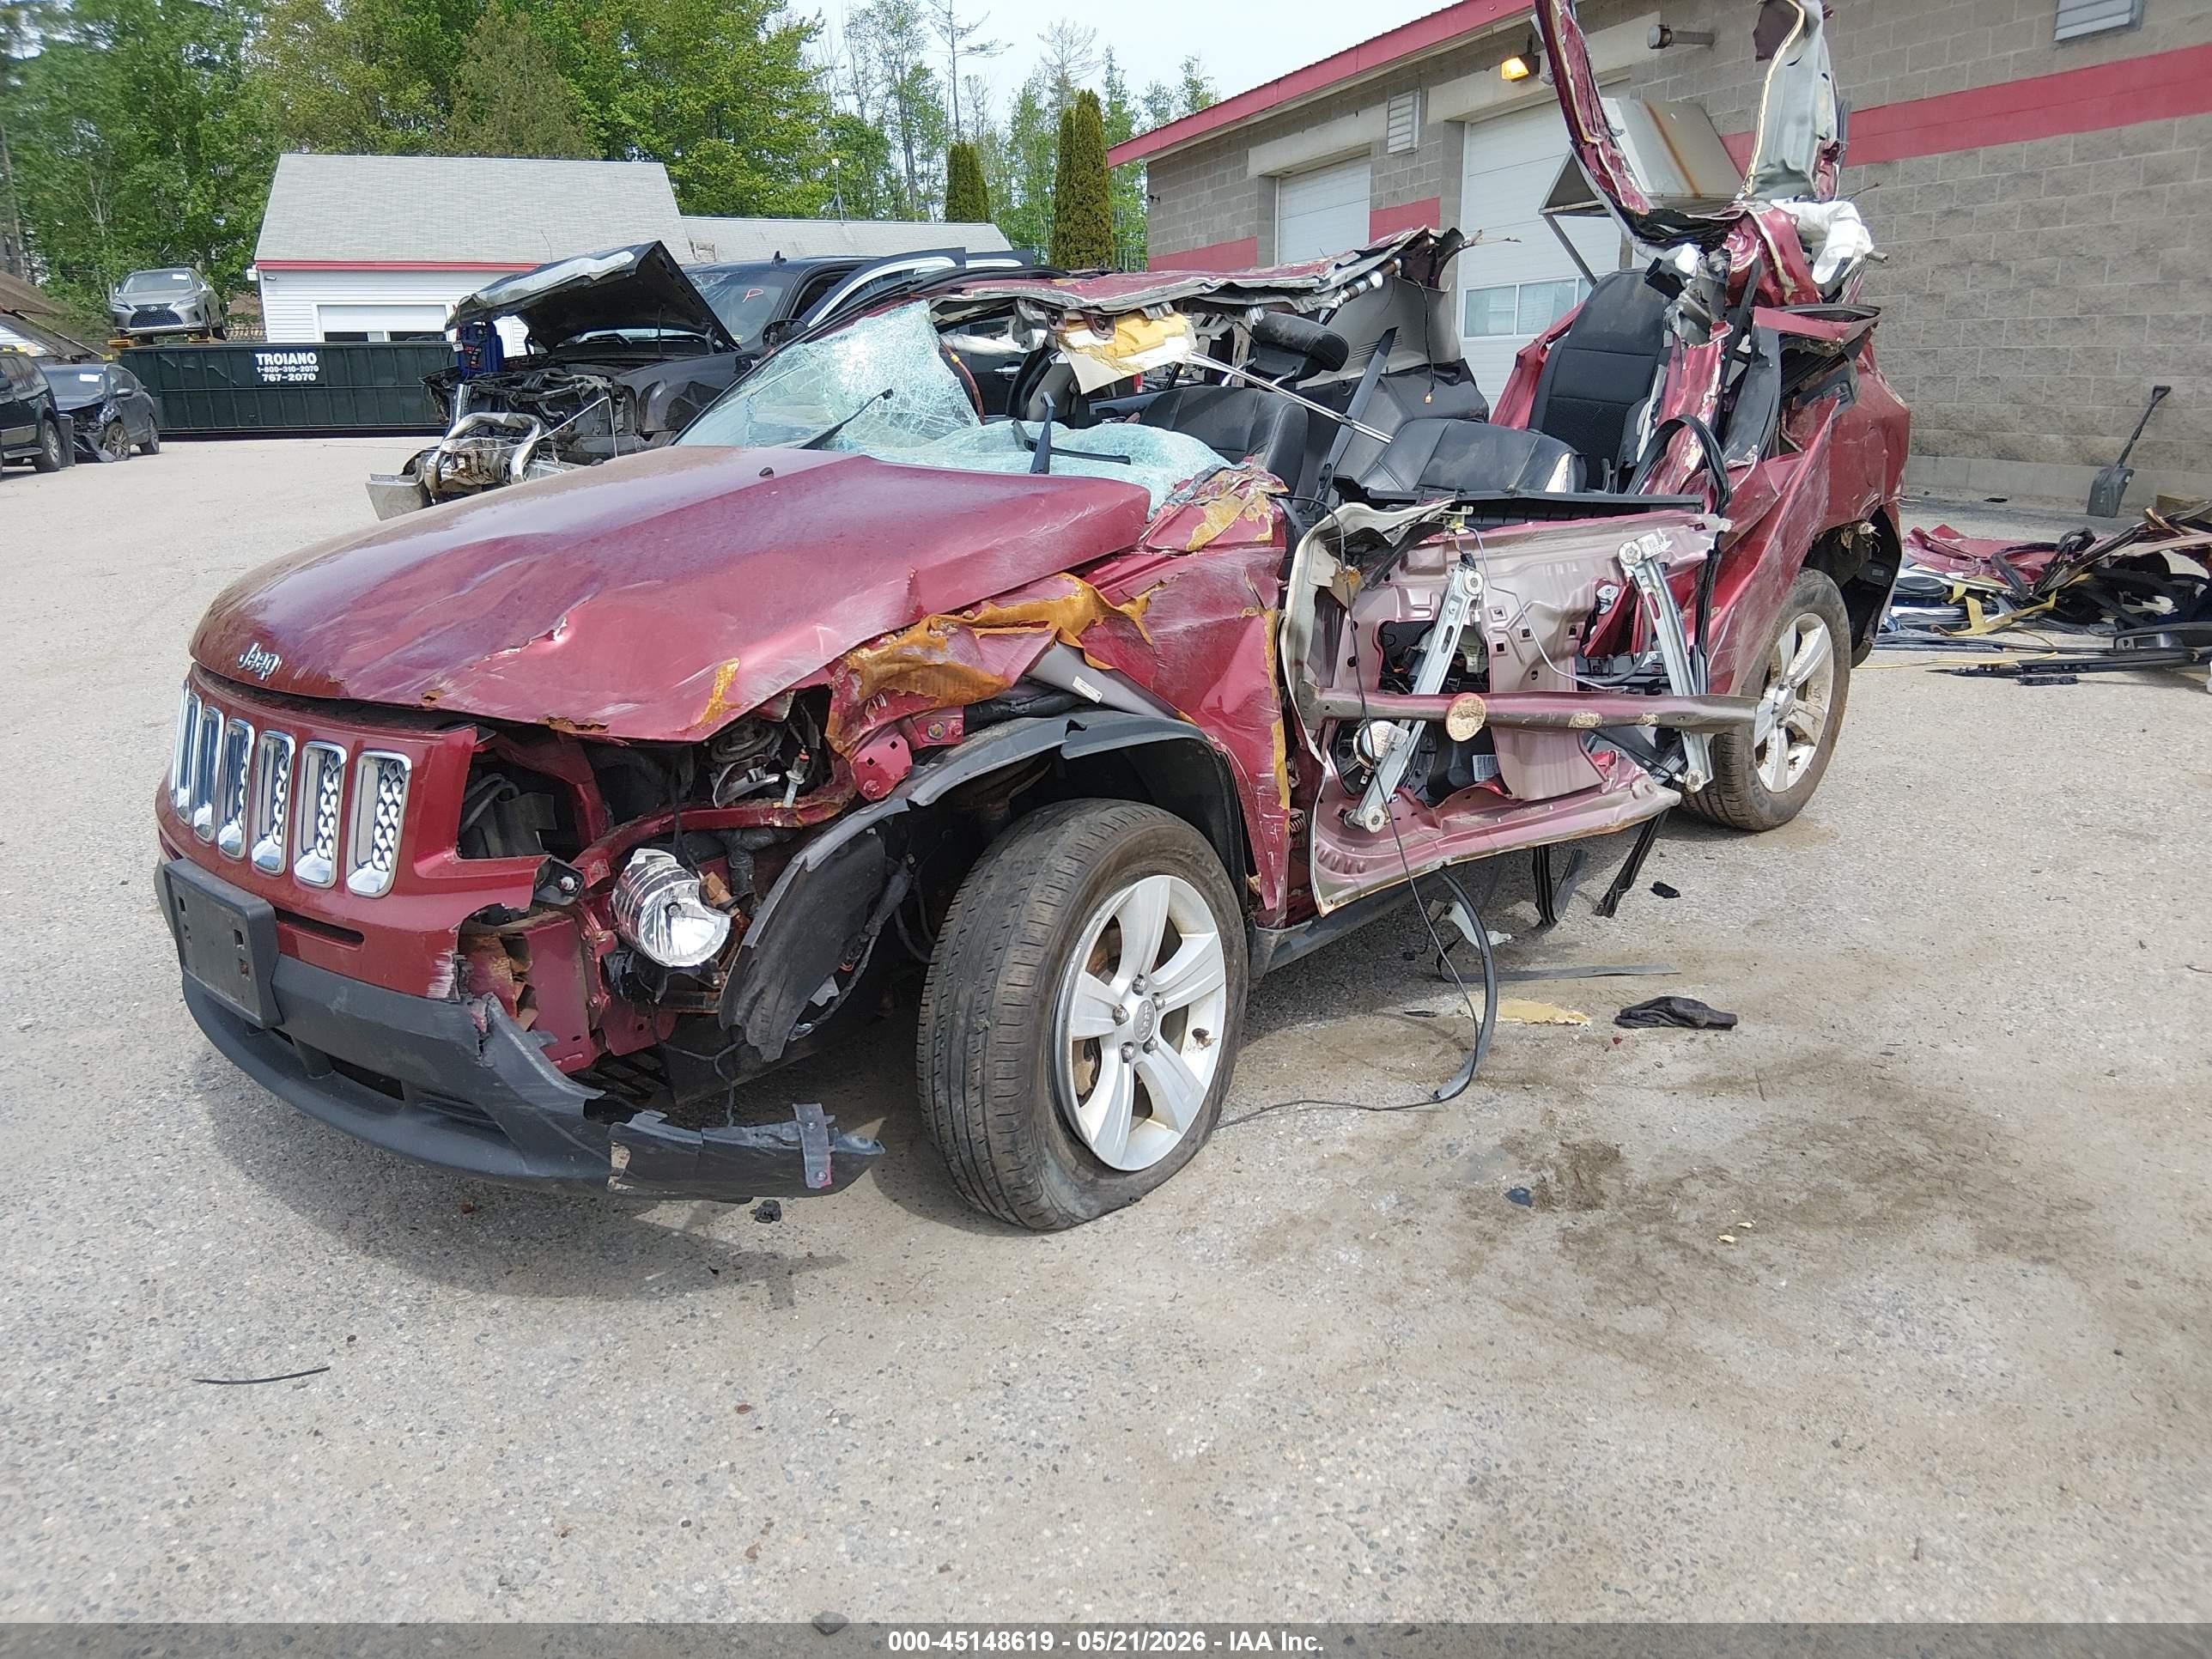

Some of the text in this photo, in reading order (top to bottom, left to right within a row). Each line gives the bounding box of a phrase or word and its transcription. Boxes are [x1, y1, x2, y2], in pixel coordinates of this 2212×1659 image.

[255, 352, 318, 366] TROIANO
[256, 365, 319, 374] 1-800-310-2070
[262, 373, 316, 382] 767-2070
[237, 642, 280, 680] Jeep
